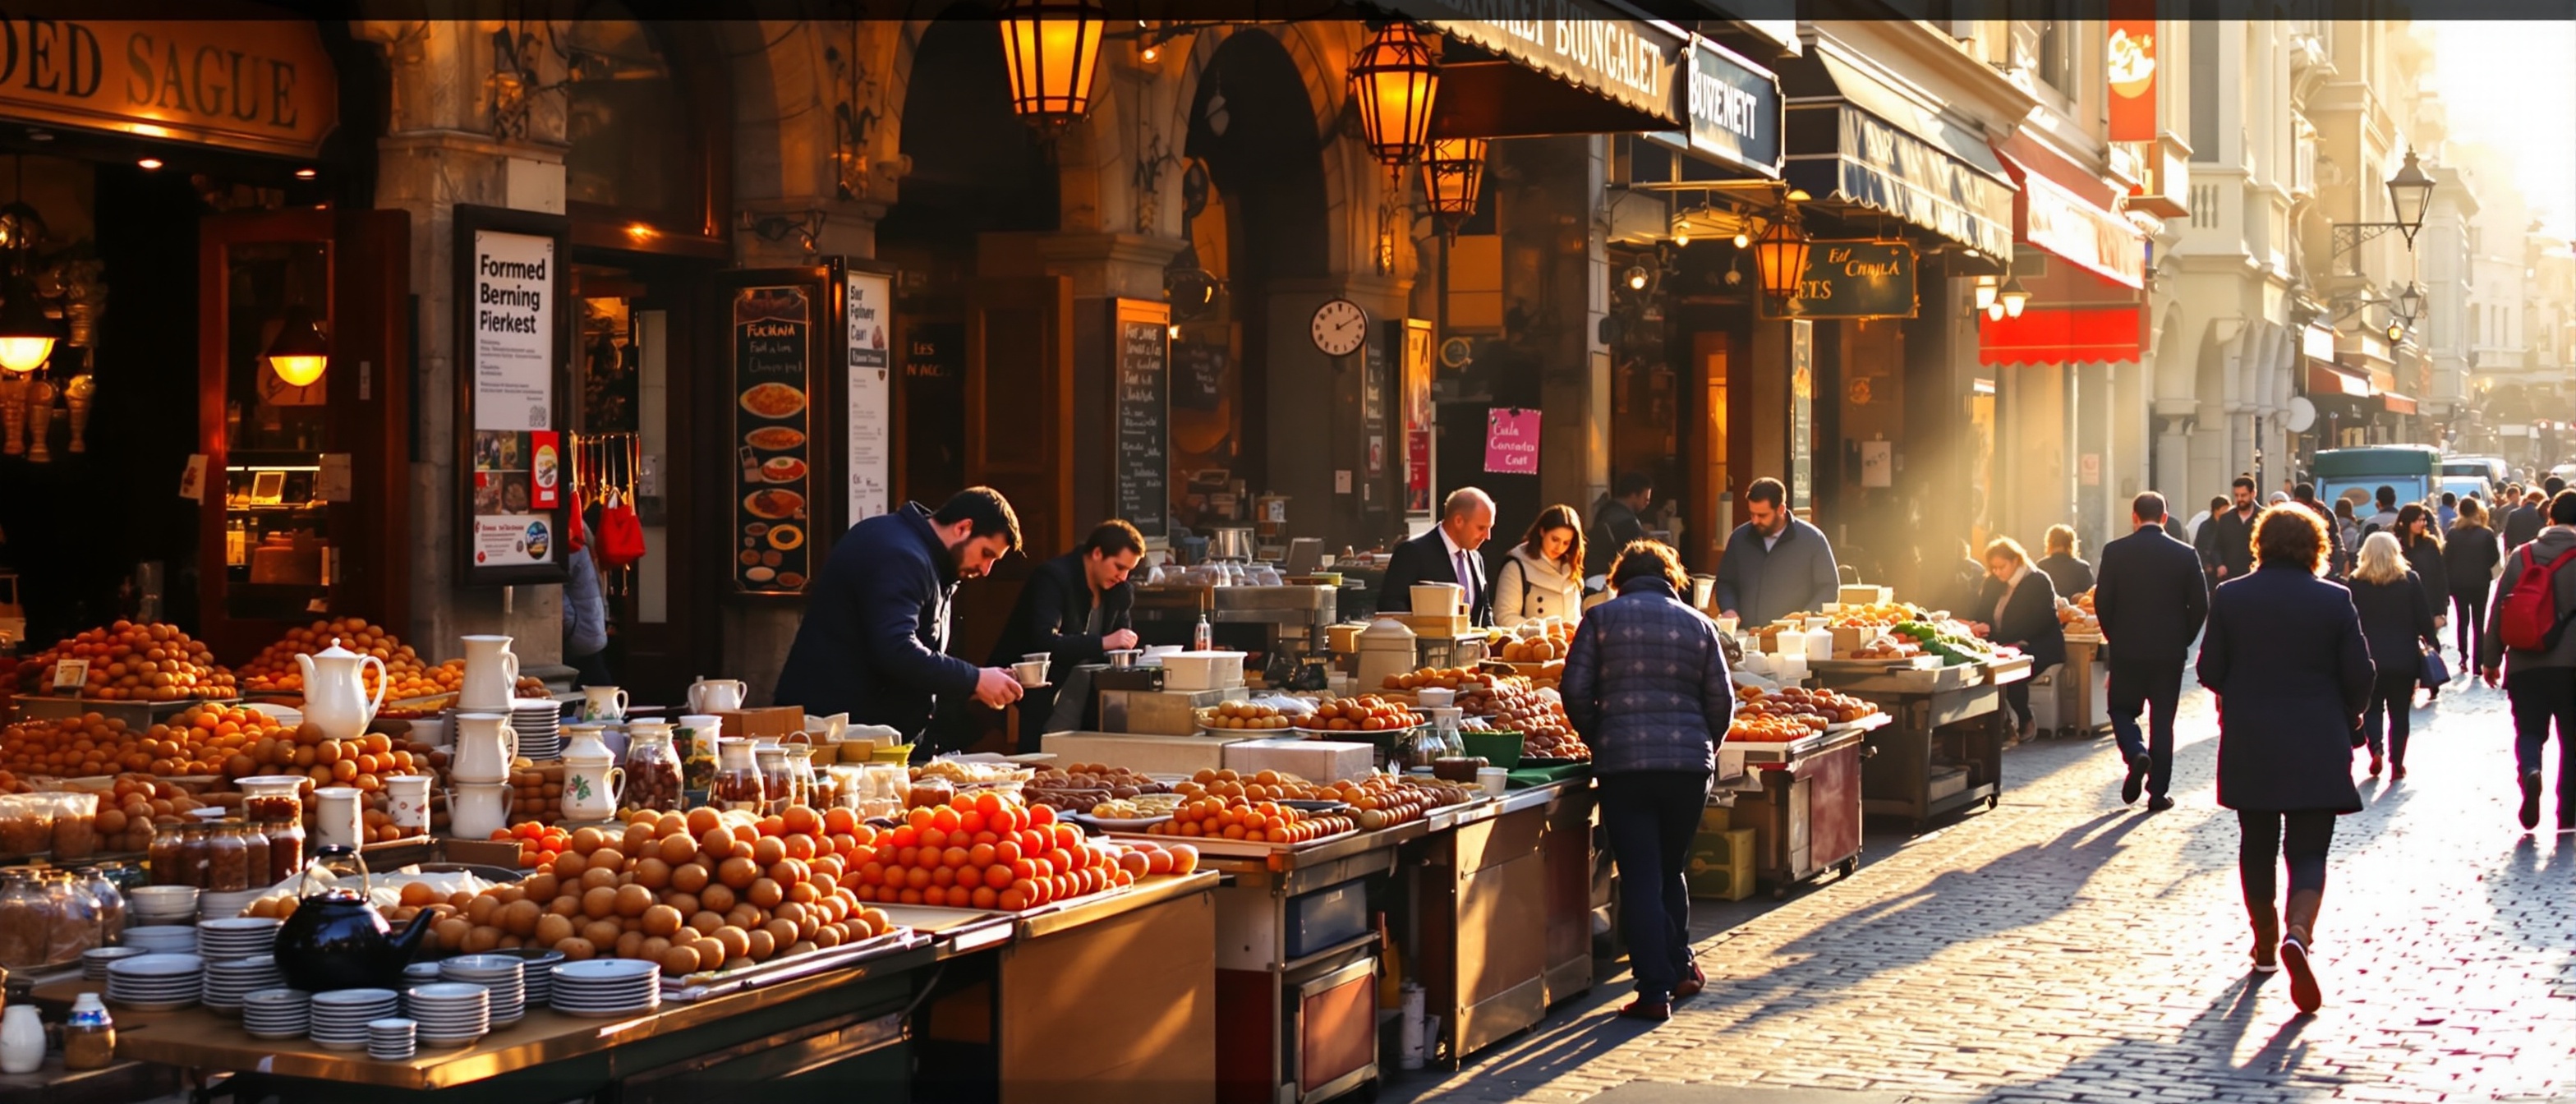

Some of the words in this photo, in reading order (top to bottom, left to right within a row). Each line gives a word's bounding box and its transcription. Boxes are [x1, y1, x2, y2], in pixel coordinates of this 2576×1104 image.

[126, 32, 297, 129] SAGUE
[481, 283, 540, 312] Berning
[1796, 279, 1832, 299] ETS
[480, 310, 536, 334] Pierkest
